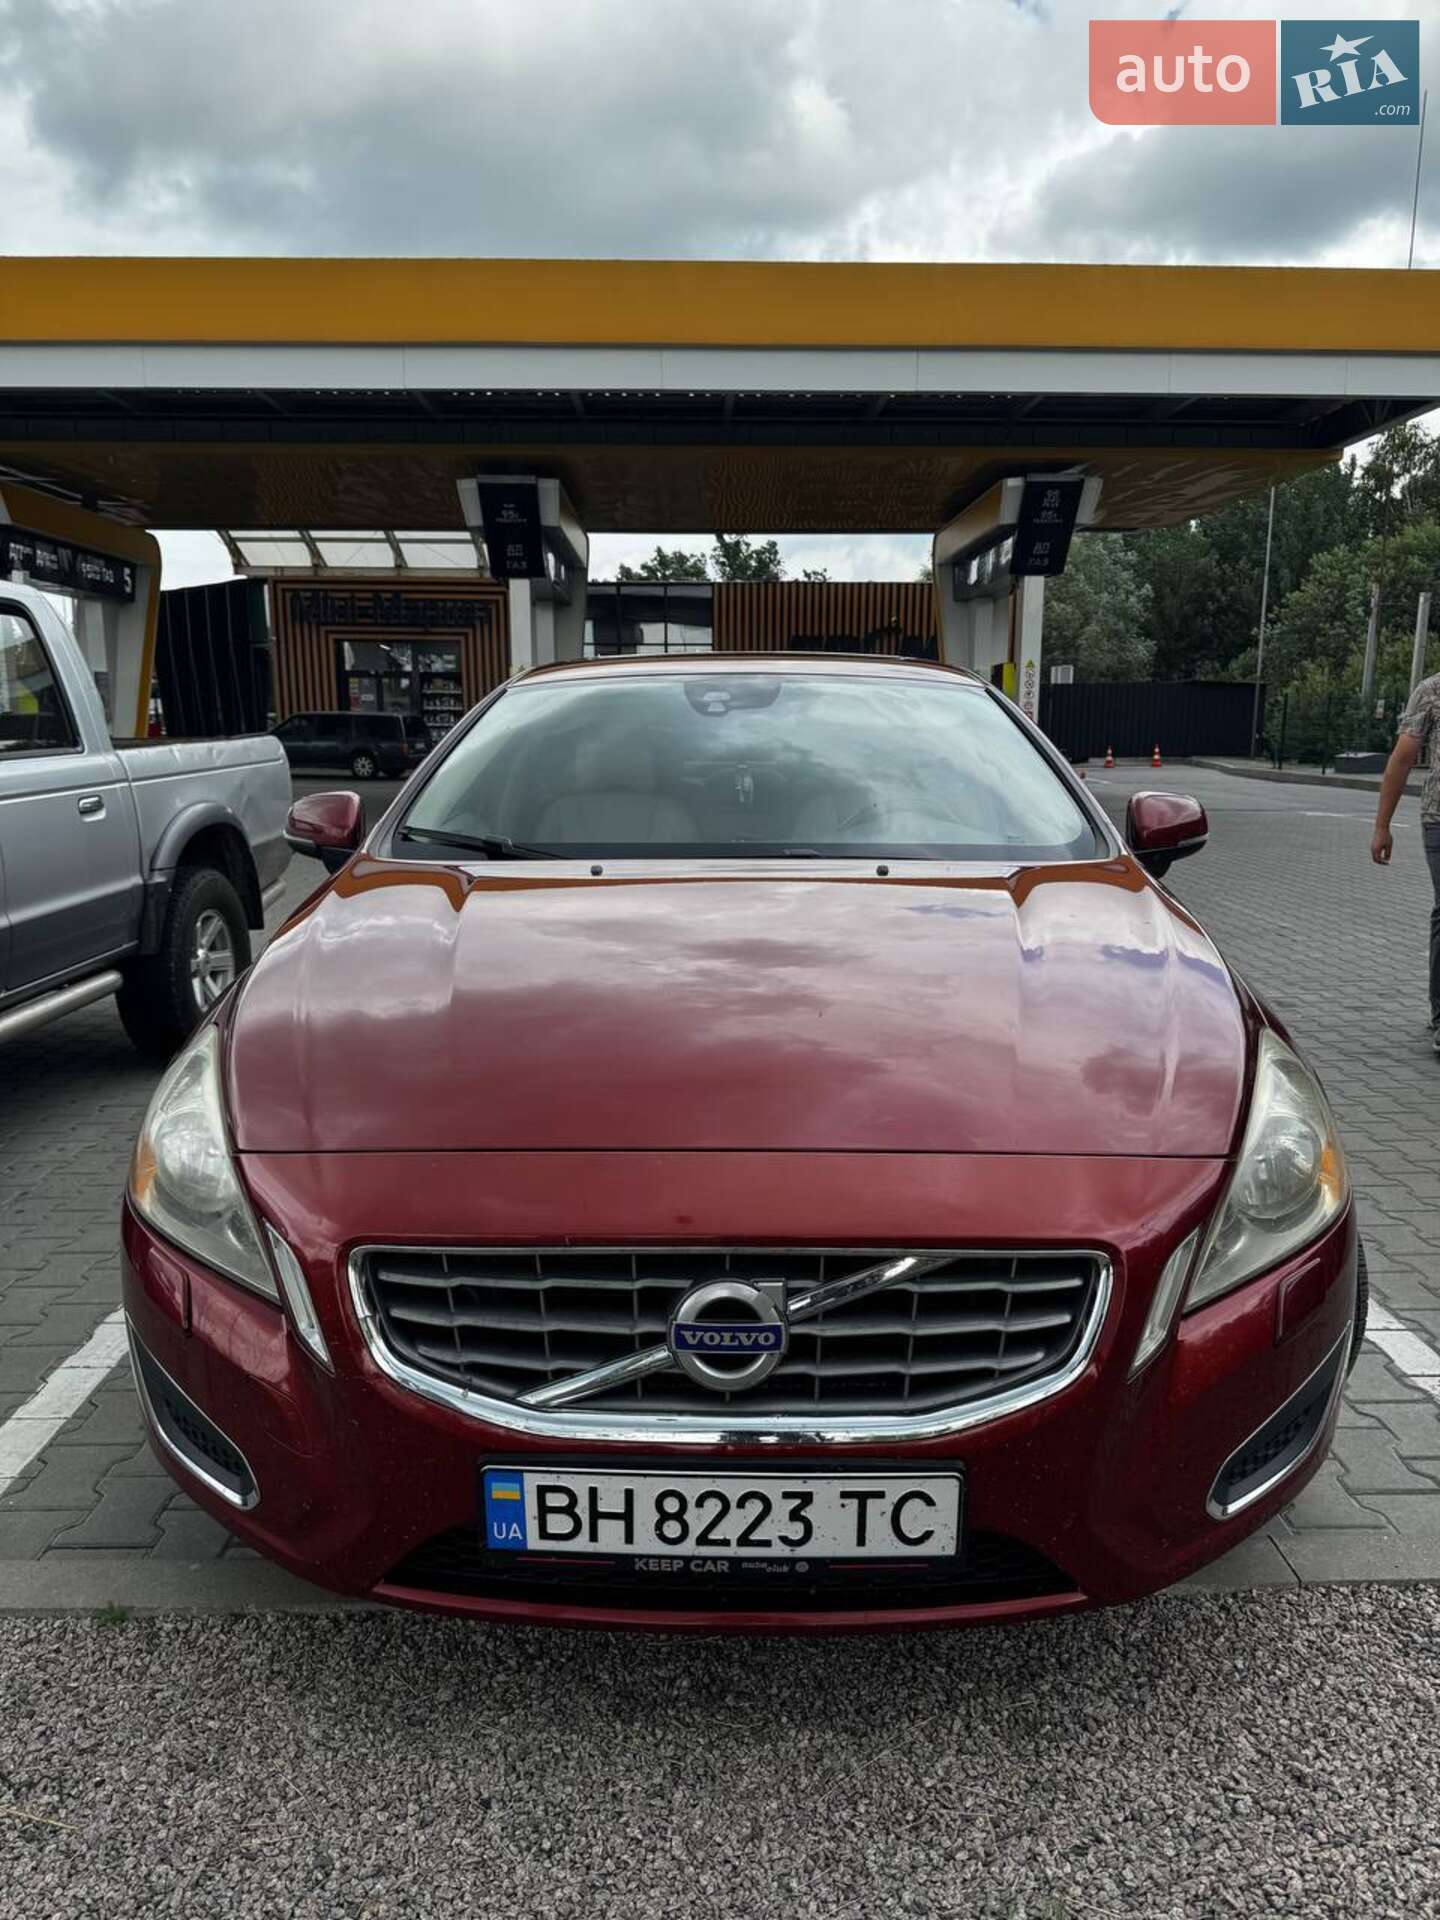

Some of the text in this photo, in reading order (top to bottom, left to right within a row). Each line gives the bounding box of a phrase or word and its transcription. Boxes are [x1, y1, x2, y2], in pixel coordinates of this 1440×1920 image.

[123, 566, 132, 593] 5
[680, 1330, 776, 1345] VOLVO
[535, 1484, 937, 1548] BH 8223 TC
[493, 1522, 523, 1541] UA
[634, 1558, 684, 1572] KEEP
[690, 1559, 729, 1573] CAR
